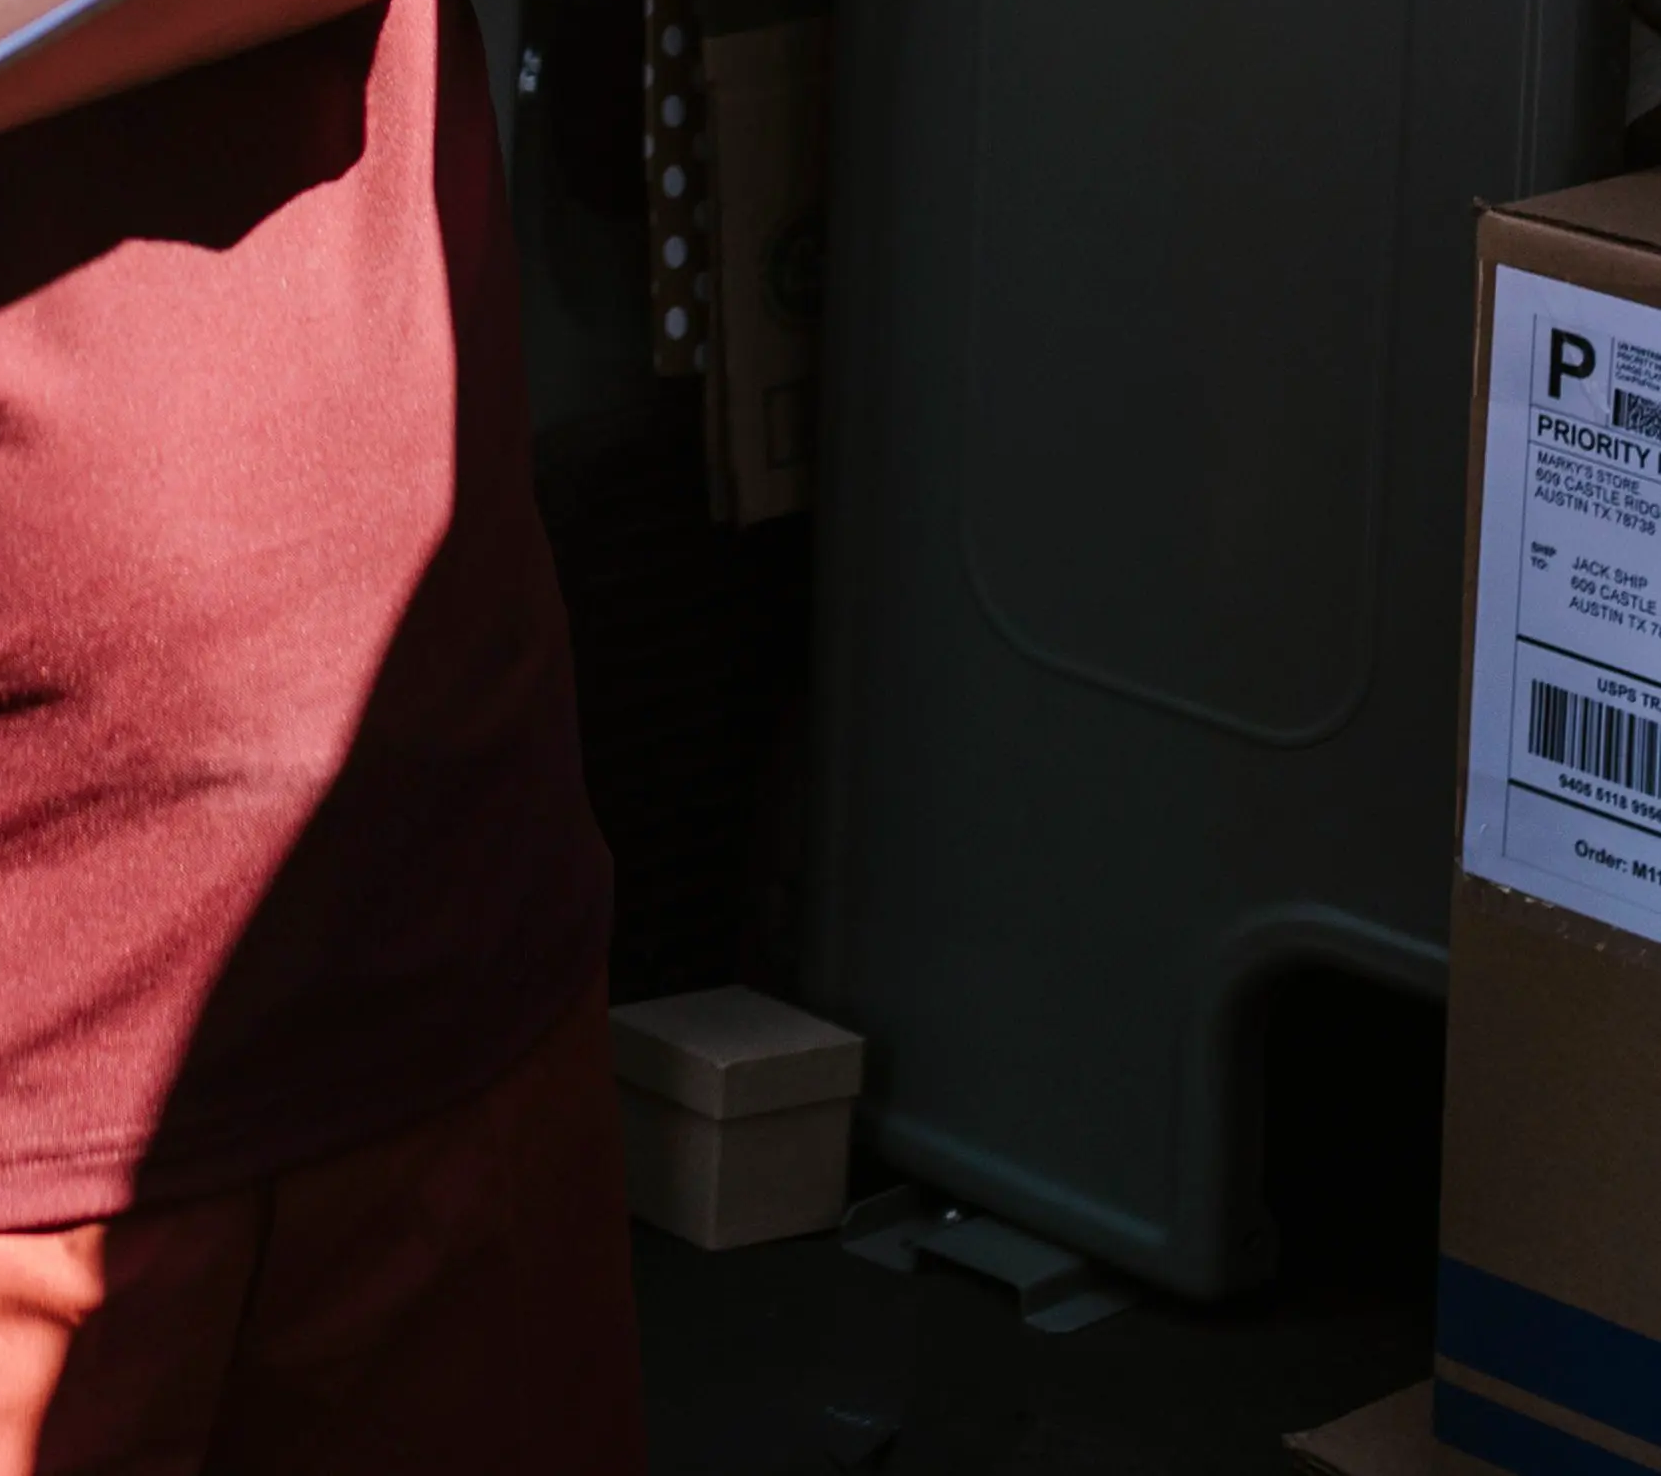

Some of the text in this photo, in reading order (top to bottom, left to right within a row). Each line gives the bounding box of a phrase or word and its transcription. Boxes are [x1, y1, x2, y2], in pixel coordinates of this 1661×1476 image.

[1548, 326, 1596, 400] P
[1537, 413, 1650, 468] PRIORITY
[1564, 476, 1620, 506] CASTLE
[1597, 468, 1640, 495] STORE
[1535, 486, 1588, 514] AUSTIN
[1593, 501, 1612, 521] TX
[1572, 556, 1648, 588] JACK SHIP
[1571, 575, 1657, 616] 609 CASTLE
[1569, 596, 1623, 625] AUSTIN
[1628, 613, 1647, 633] TX
[1597, 677, 1637, 703] USPS
[1574, 839, 1627, 873] Order:
